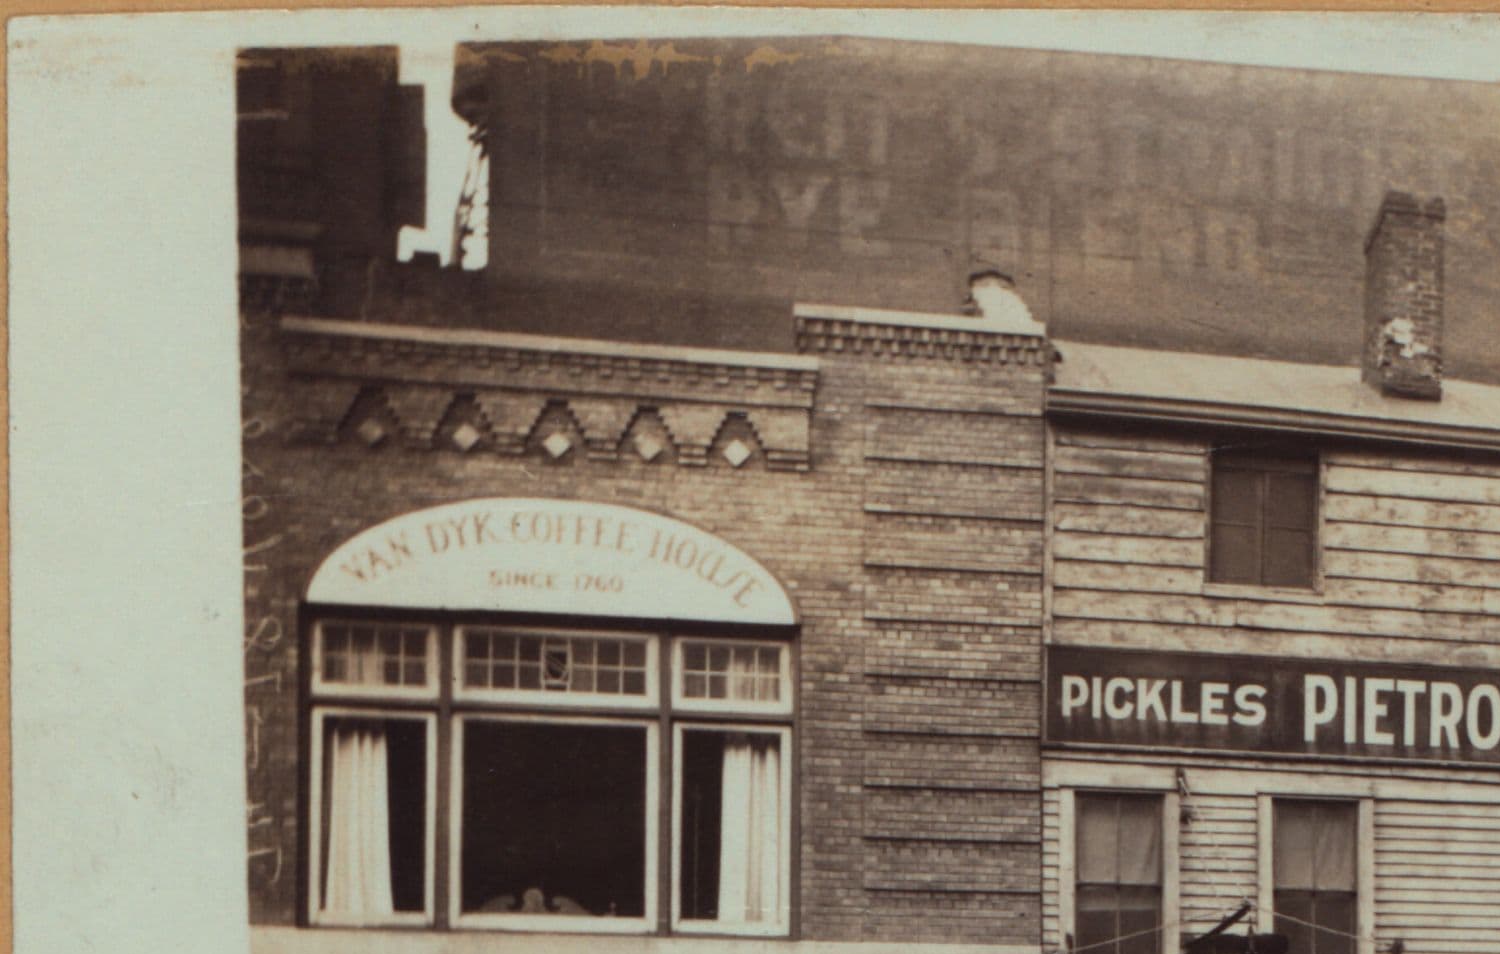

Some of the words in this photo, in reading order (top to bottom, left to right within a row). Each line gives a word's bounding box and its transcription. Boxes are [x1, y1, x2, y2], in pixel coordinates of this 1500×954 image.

[340, 535, 411, 584] VAN
[425, 511, 498, 556] DYK
[510, 511, 641, 556] COFFEE
[650, 529, 766, 609] HOUSE
[489, 569, 559, 592] SINCE
[574, 572, 625, 594] 1760
[1061, 674, 1267, 727] PICKLES
